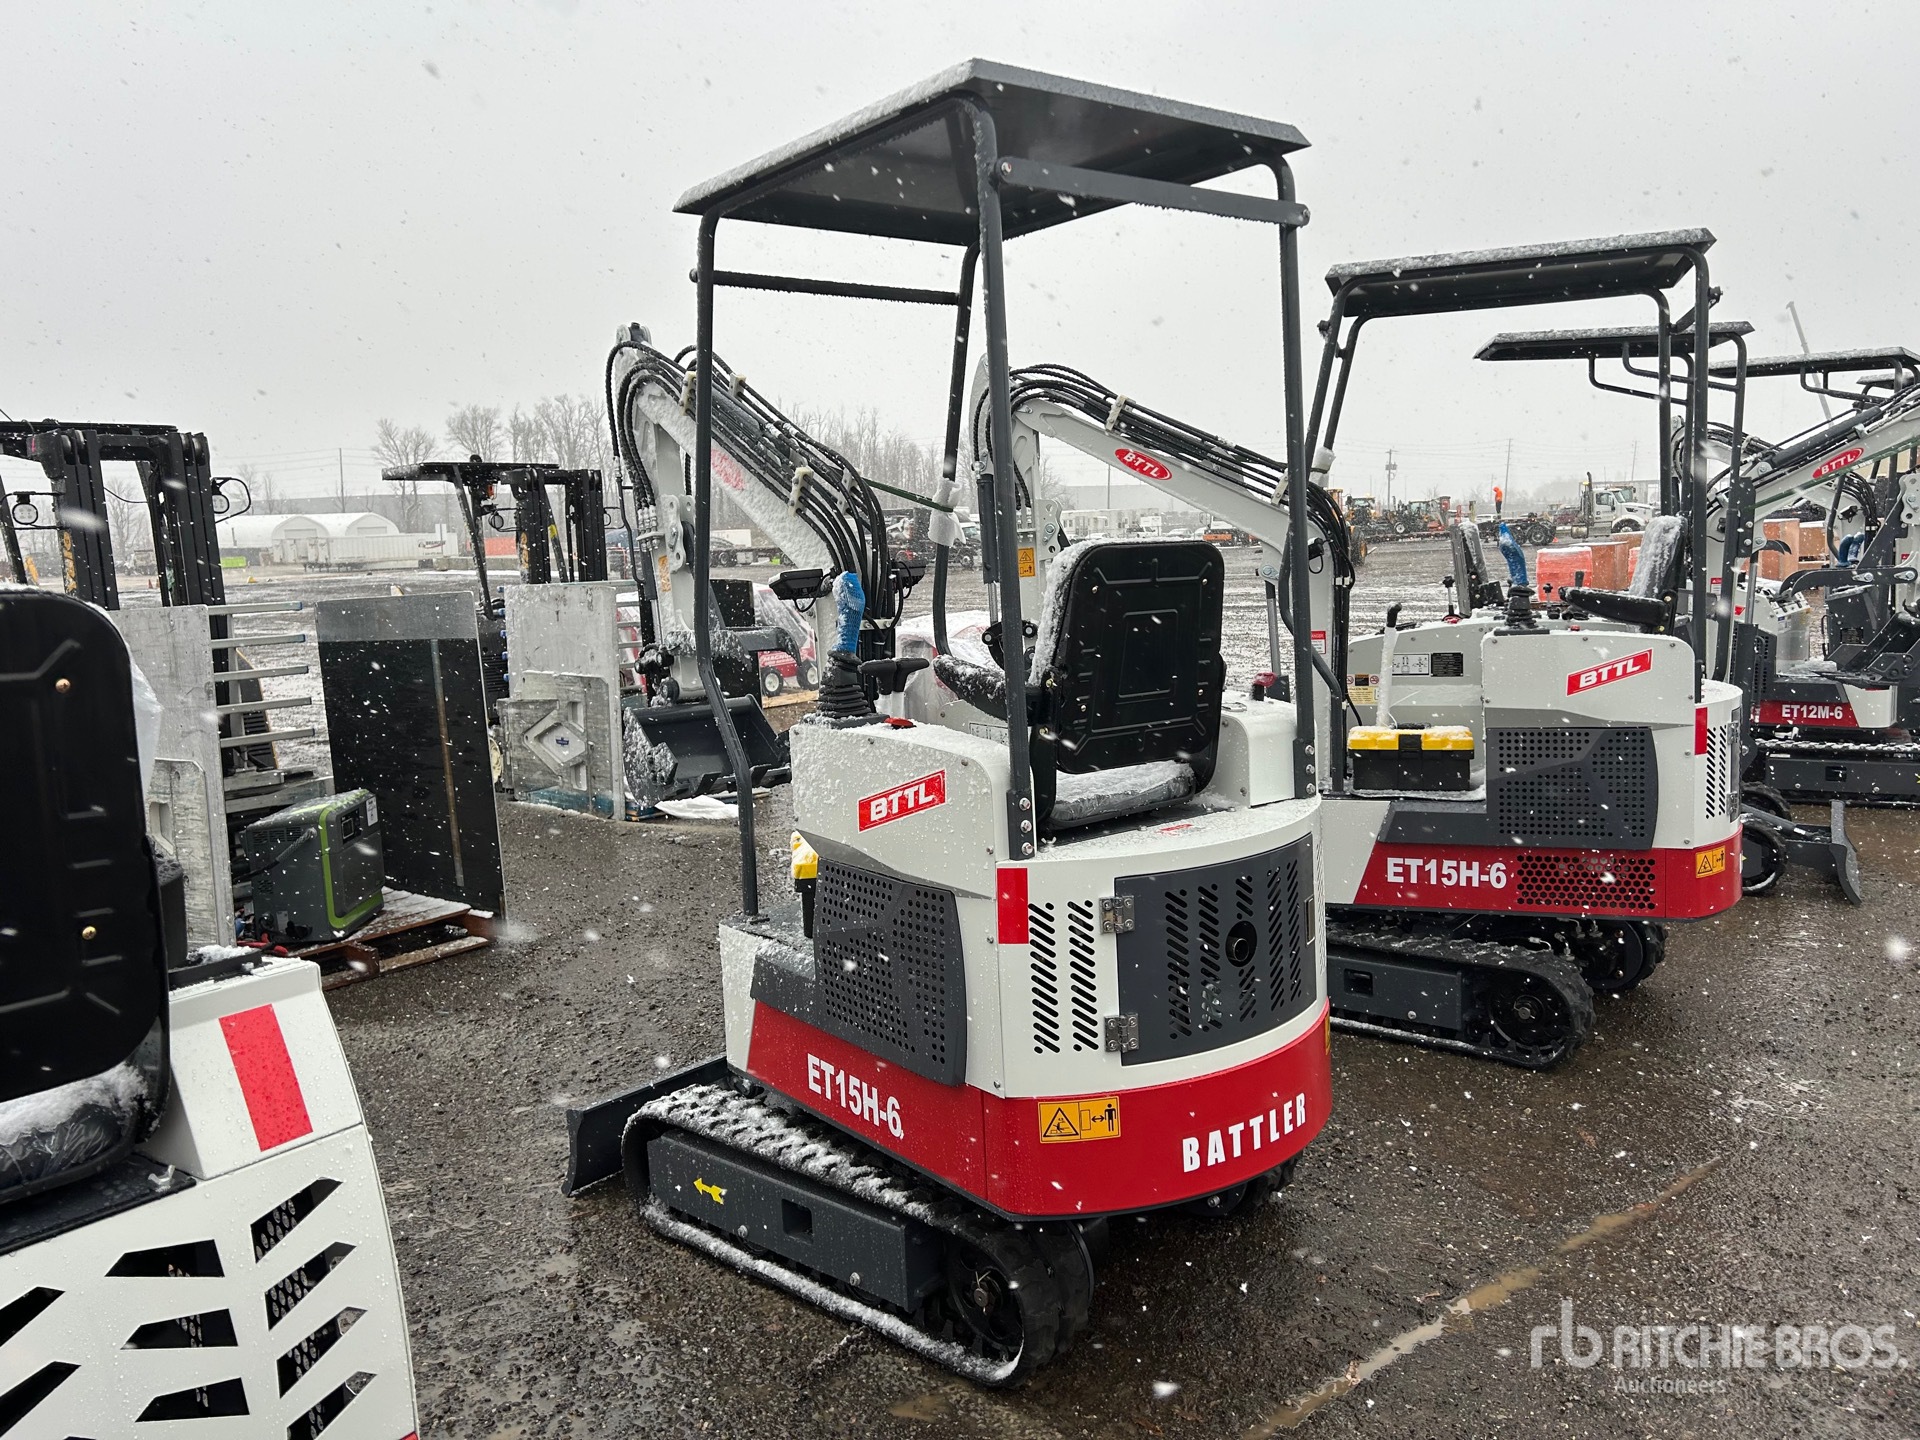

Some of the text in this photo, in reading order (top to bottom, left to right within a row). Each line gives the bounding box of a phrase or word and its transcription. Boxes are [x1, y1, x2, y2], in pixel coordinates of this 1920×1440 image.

[1123, 452, 1159, 477] BTTL
[1821, 453, 1855, 475] BTTL
[1579, 658, 1641, 688] BTTL
[1781, 704, 1843, 720] ET12M-6
[870, 782, 936, 822] BTTL
[1386, 857, 1507, 889] ET15H-6
[807, 1053, 902, 1138] ET15H-6
[1182, 1092, 1306, 1173] BATTLER
